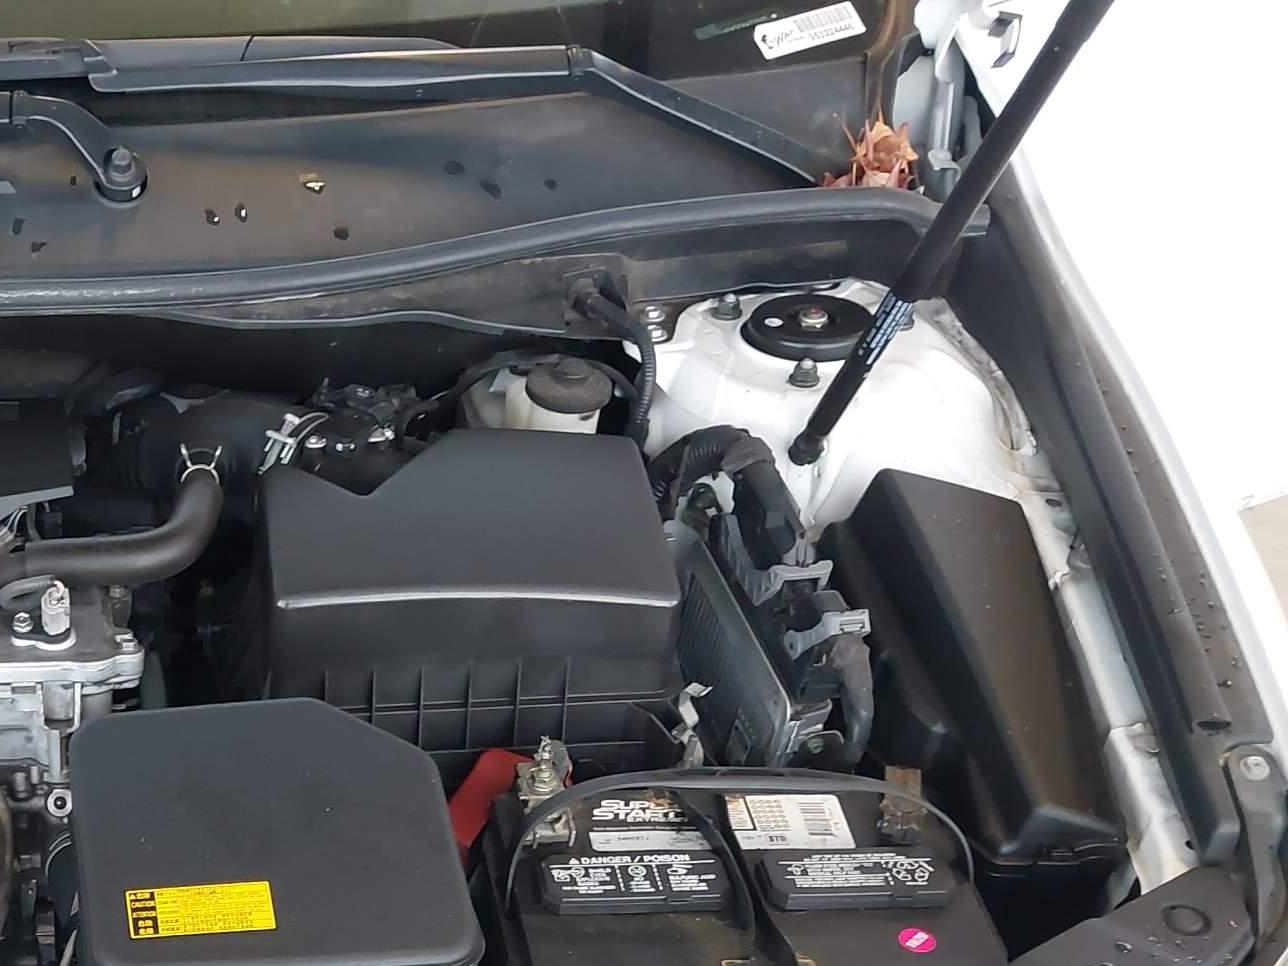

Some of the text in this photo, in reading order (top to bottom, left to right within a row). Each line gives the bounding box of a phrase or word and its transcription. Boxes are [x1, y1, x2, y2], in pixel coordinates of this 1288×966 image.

[601, 799, 678, 809] SUP
[581, 856, 631, 864] DANGER
[643, 854, 690, 862] POISON
